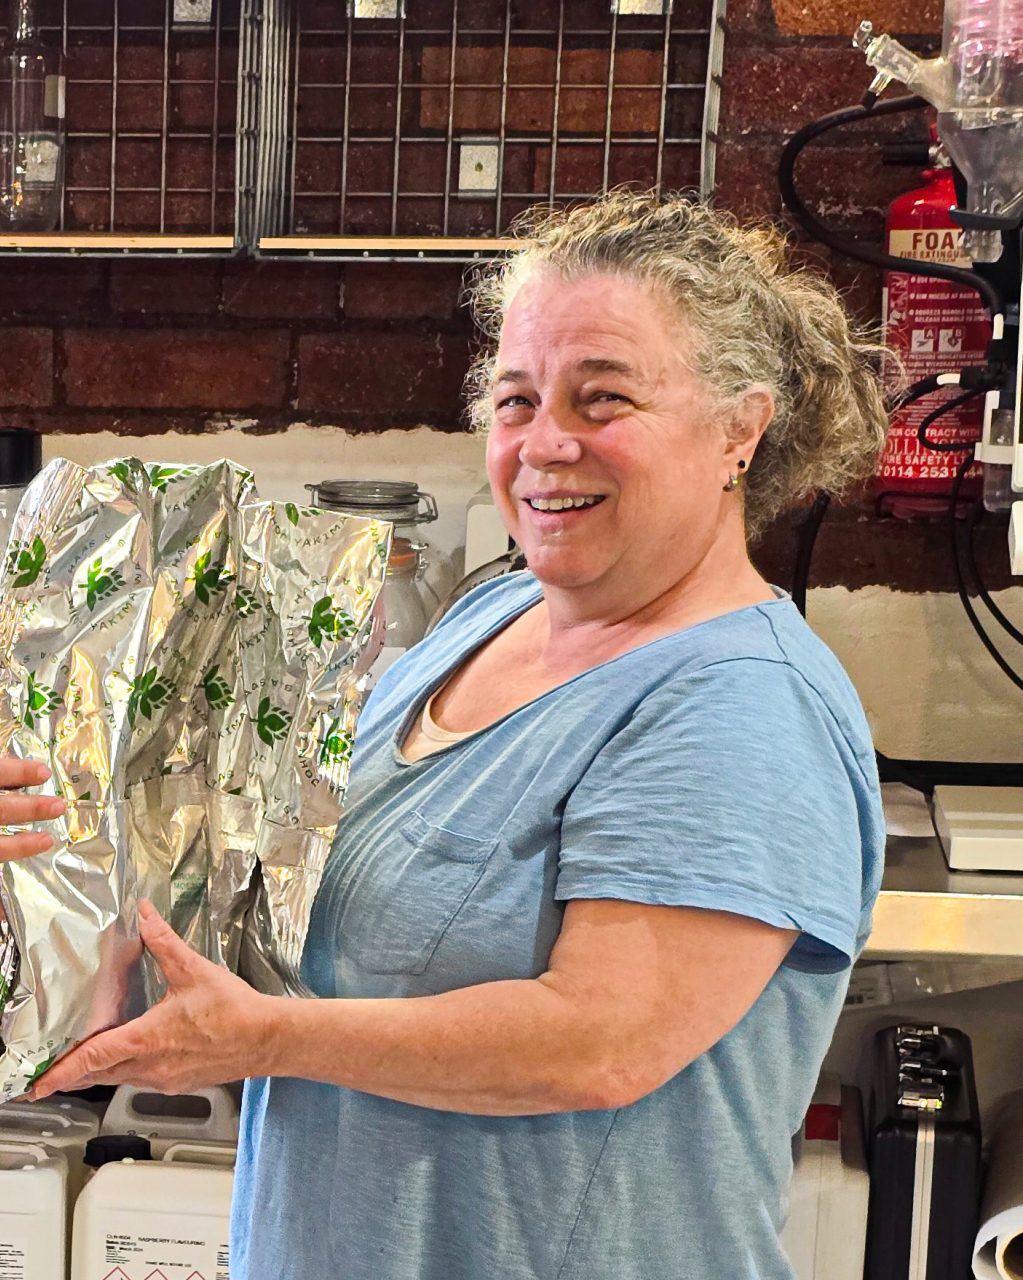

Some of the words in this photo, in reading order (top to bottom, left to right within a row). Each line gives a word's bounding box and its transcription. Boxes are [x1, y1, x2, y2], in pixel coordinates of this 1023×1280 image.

[912, 231, 964, 250] FOA
[904, 428, 957, 436] COTRACT
[905, 455, 950, 465] SAFETY
[953, 455, 966, 464] LT
[920, 466, 983, 479] 253144
[294, 516, 348, 548] YAKIMA
